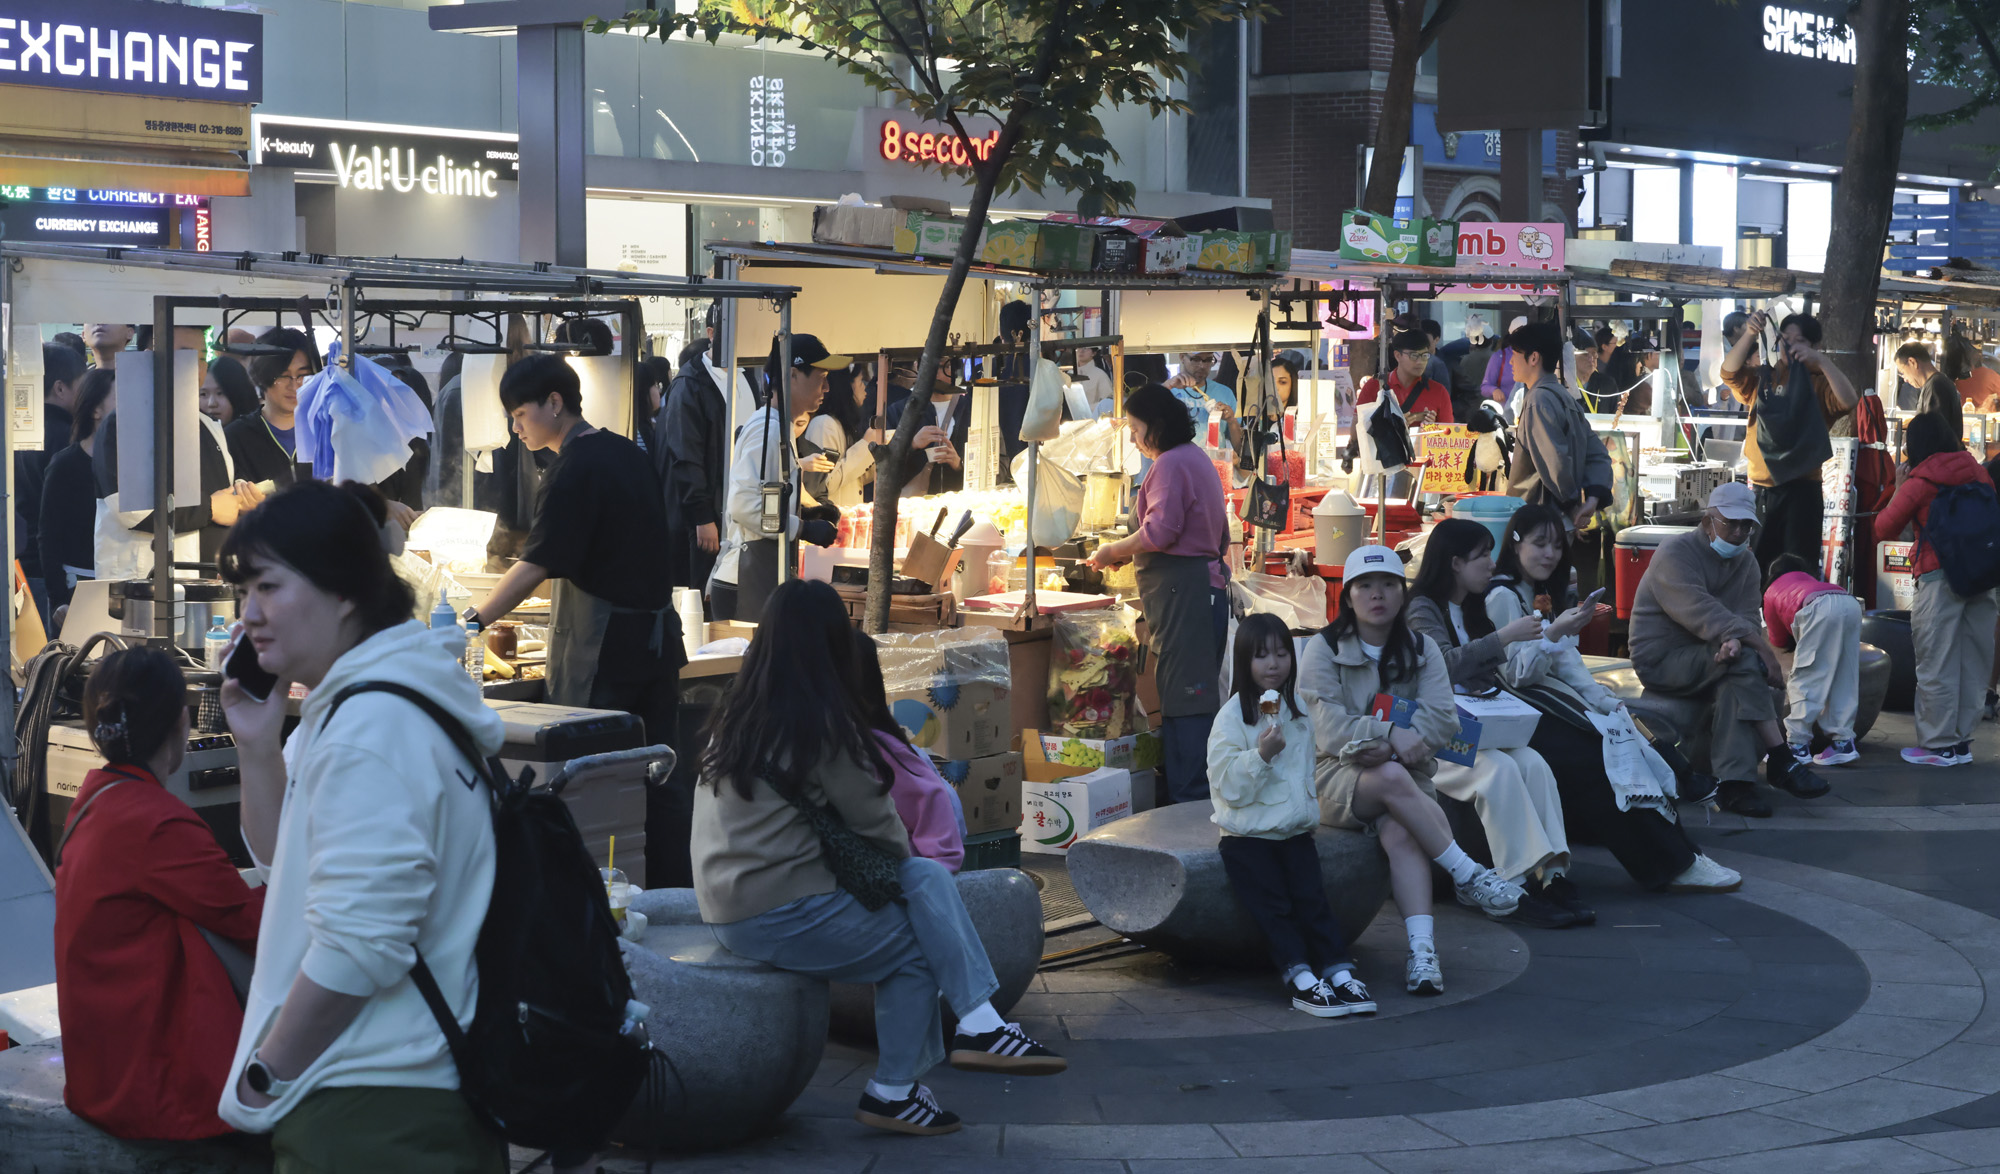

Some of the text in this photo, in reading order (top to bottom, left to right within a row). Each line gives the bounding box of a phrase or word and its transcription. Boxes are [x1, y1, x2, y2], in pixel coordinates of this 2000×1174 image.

[1763, 5, 1814, 58] SHOE
[0, 17, 255, 91] EXCHANGE
[261, 136, 315, 158] K-beauty
[880, 120, 900, 160] 8
[421, 154, 498, 198] clinic
[36, 217, 159, 235] CURRENCY EXCHANGE
[1426, 437, 1448, 449] MARA
[1449, 438, 1470, 449] LAMB
[1426, 471, 1442, 483] 마라
[1606, 727, 1621, 738] NEW
